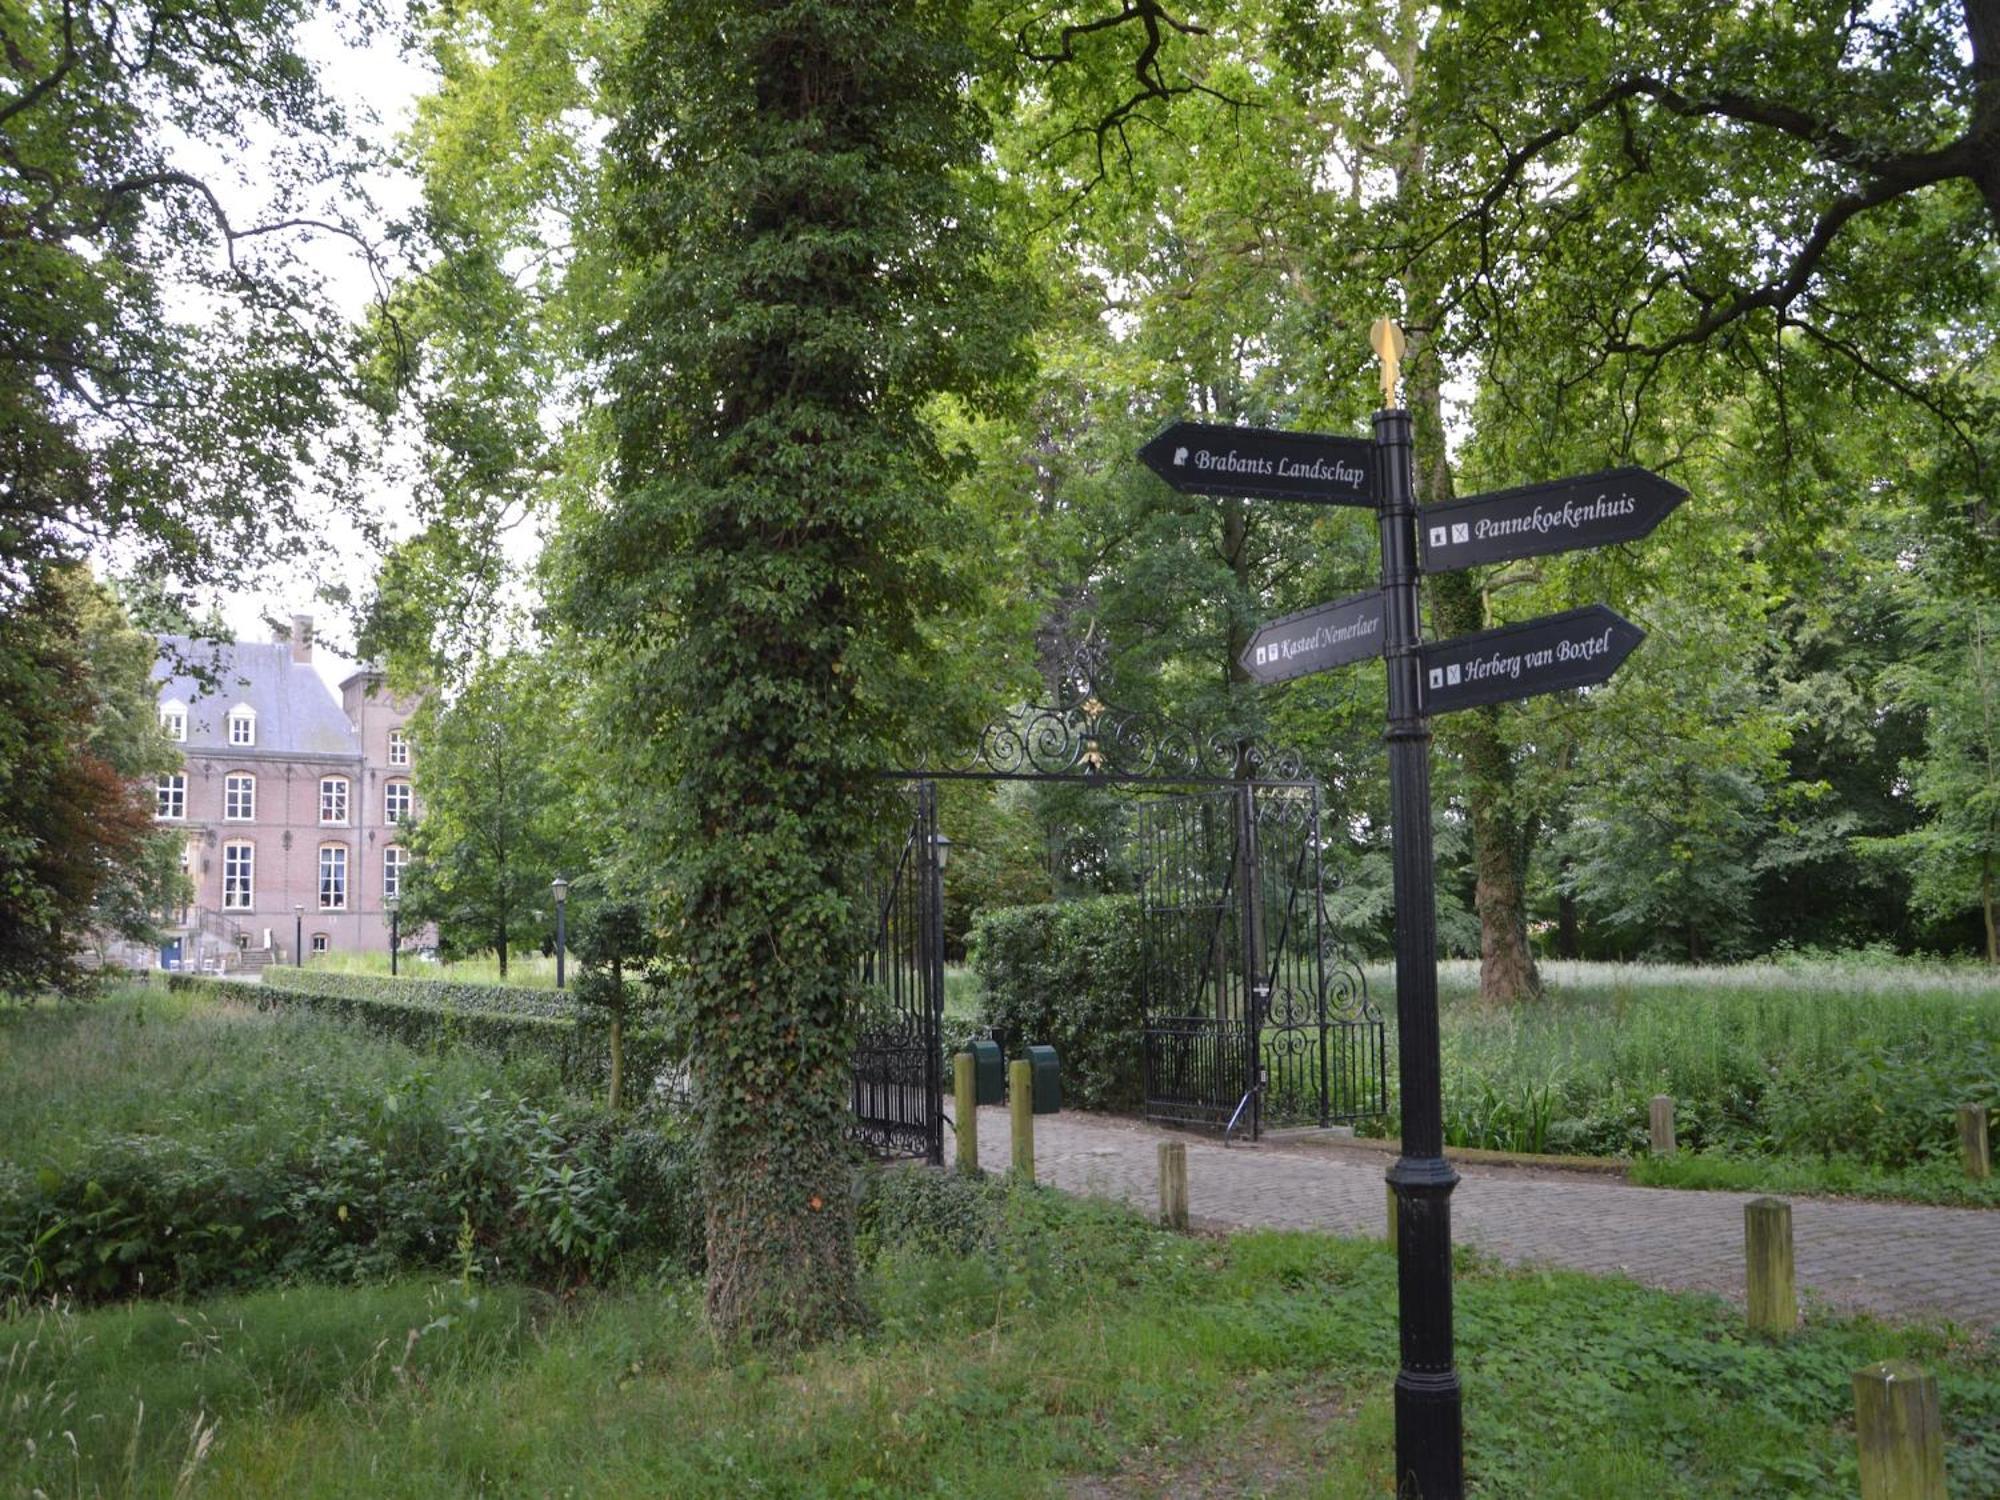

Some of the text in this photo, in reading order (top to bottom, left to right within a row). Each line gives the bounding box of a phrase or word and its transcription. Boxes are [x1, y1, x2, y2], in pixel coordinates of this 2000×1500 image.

[1195, 450, 1364, 488] Brabants Landschap
[1475, 493, 1635, 539] Pannekoekenhuis
[1281, 615, 1379, 659] Kasteel Nemerlaer
[1465, 627, 1613, 681] Herberg van Boxtel
